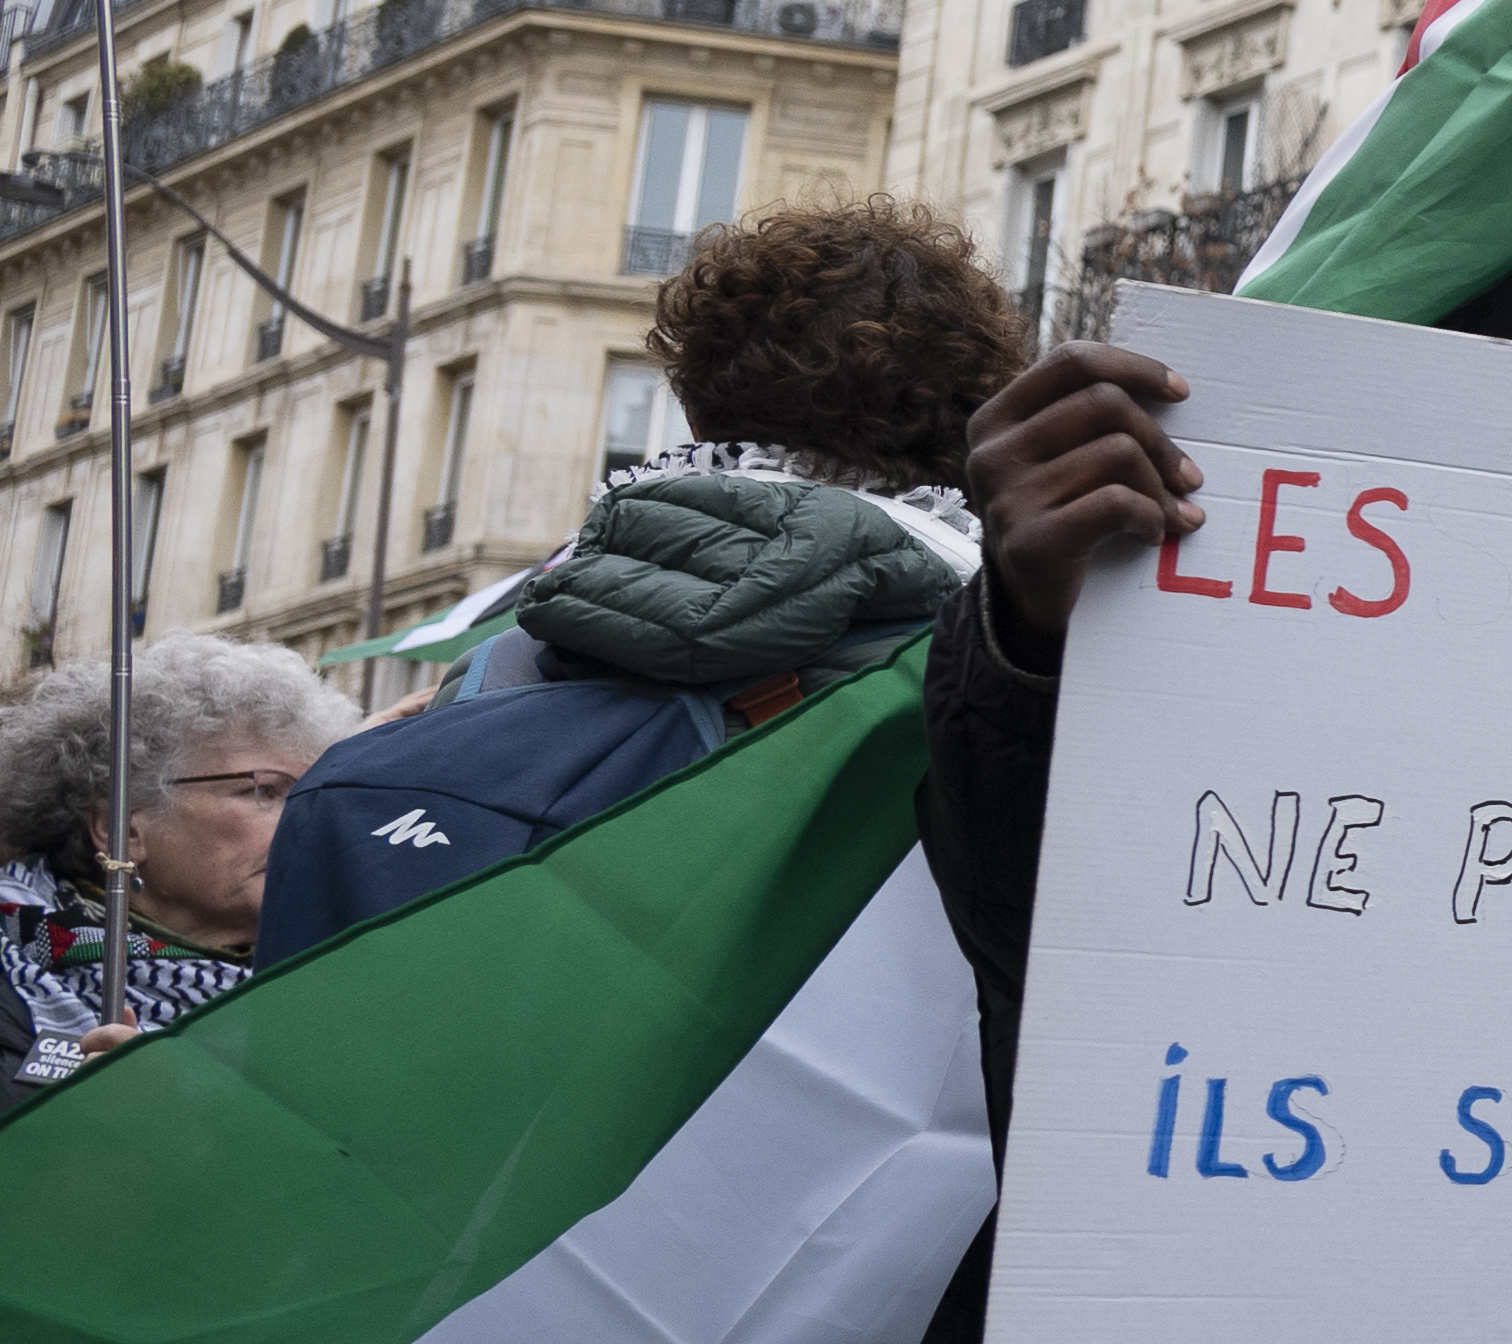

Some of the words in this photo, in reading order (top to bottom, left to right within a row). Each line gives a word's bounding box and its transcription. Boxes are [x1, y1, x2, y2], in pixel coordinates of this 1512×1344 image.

[1157, 469, 1412, 619] LES
[1183, 790, 1386, 918] NE
[25, 1061, 52, 1077] ON
